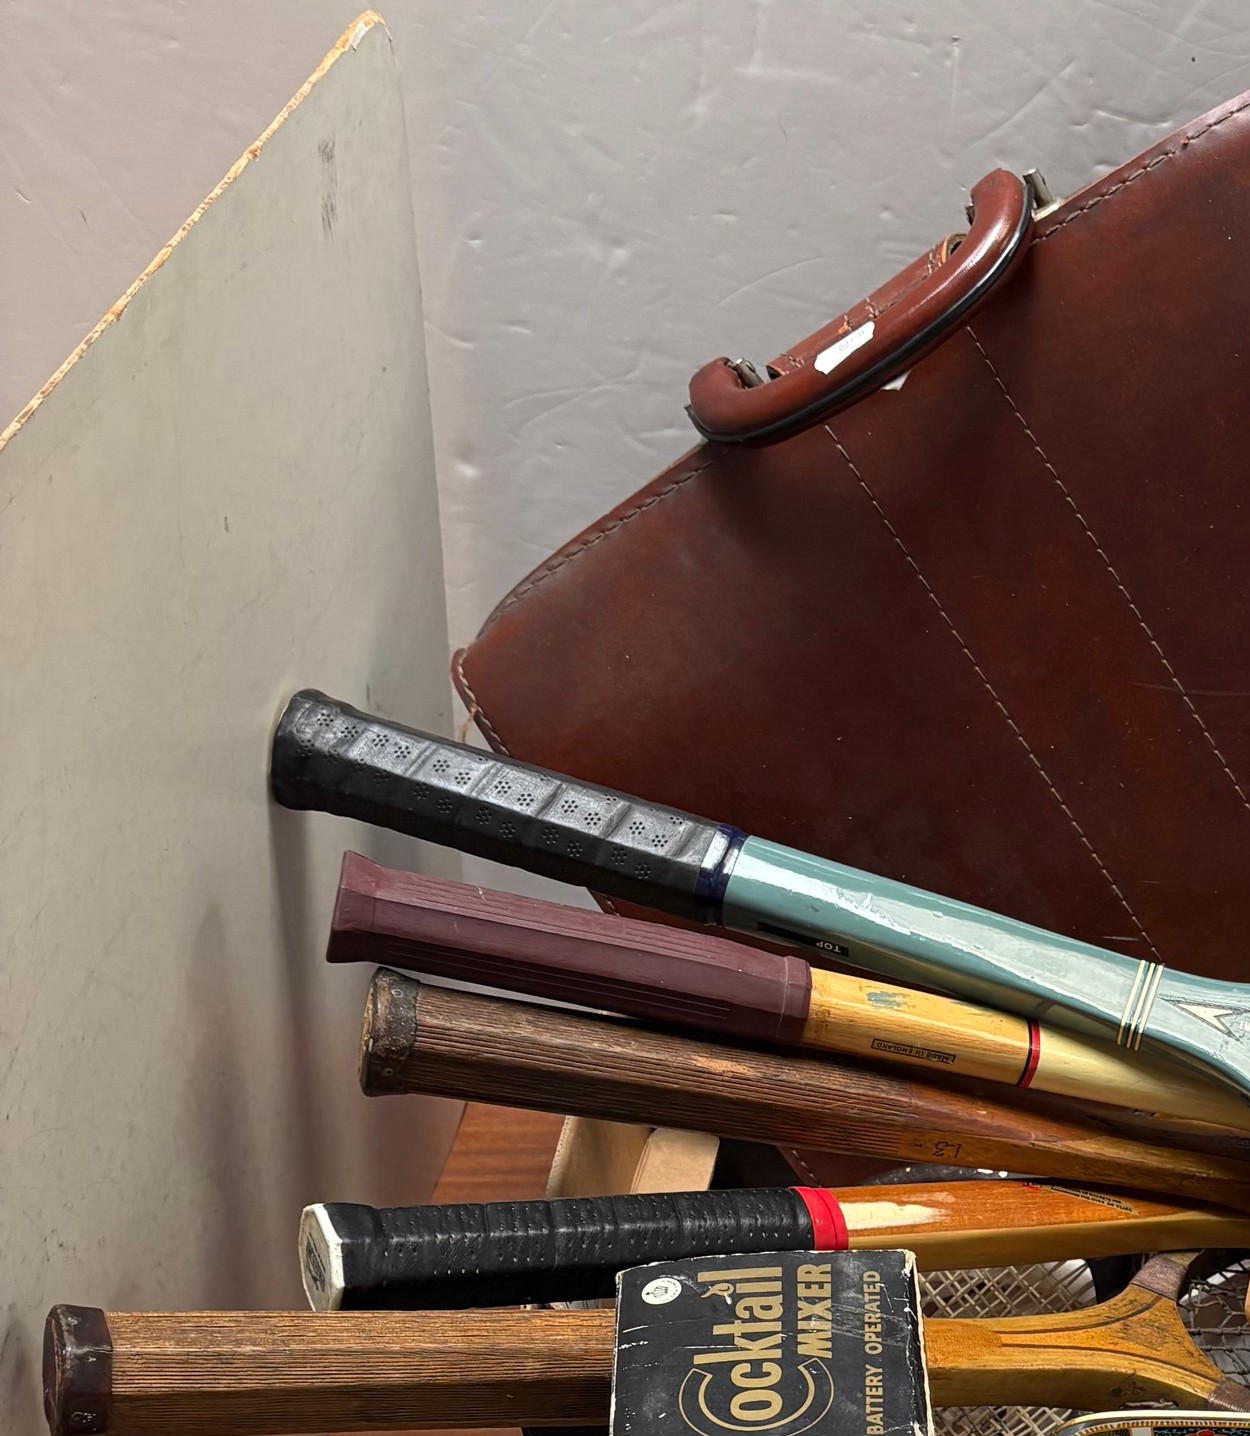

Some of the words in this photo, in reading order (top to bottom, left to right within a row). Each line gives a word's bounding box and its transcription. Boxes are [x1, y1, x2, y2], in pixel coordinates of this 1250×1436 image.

[816, 939, 843, 954] TOP
[797, 1263, 833, 1360] MIXER
[862, 1270, 885, 1356] OPERATED
[866, 1363, 886, 1436] BATTERY
